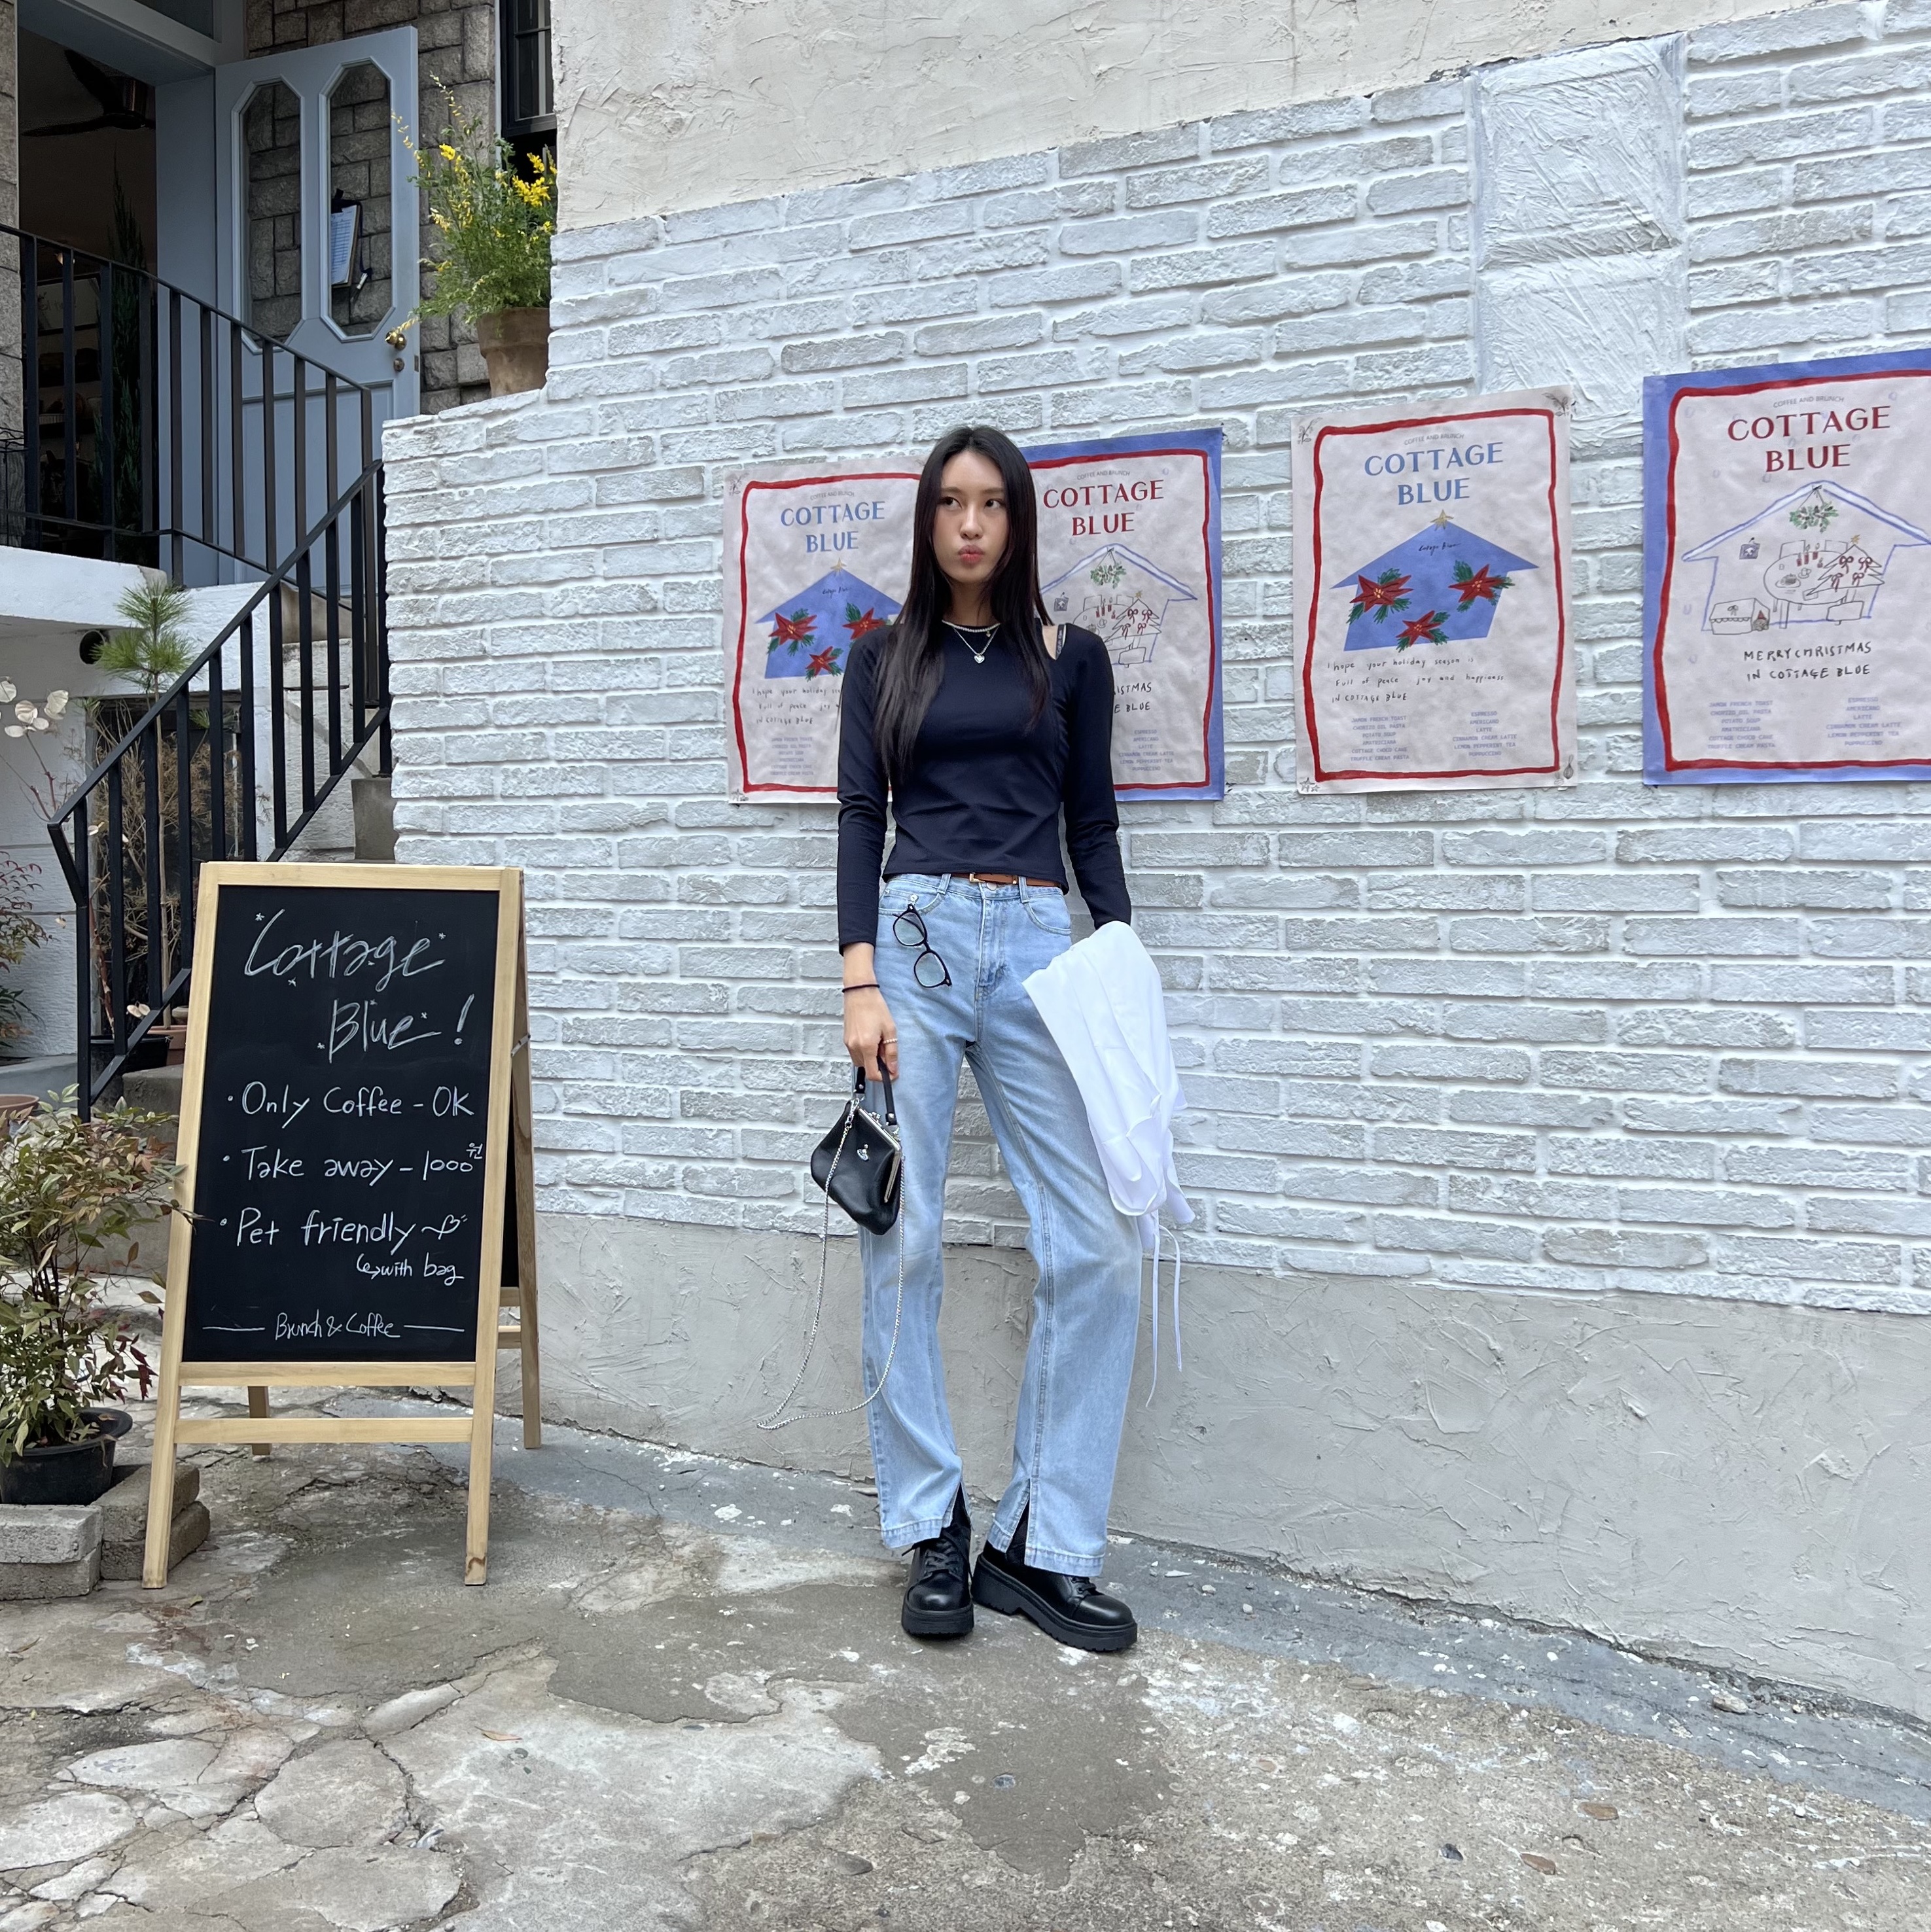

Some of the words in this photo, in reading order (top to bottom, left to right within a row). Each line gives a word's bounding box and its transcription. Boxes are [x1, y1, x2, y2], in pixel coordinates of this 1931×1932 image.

[1773, 398, 1797, 408] COFFEE
[1727, 406, 1891, 441] COTTAGE
[1404, 436, 1425, 446] COFFEE
[1364, 442, 1504, 476] COTTAGE
[1765, 444, 1851, 472] BLUE
[1077, 472, 1095, 481] COFFEE
[1043, 480, 1164, 508] COTTAGE
[1398, 478, 1470, 506] BLUE
[781, 501, 885, 526] COTTAGE
[1072, 512, 1135, 536] BLUE
[806, 531, 859, 553] BLUE
[1334, 661, 1355, 673] hope
[1367, 662, 1387, 671] your
[1393, 657, 1425, 668] holiday
[1747, 669, 1761, 682] IN
[1769, 667, 1829, 680] COTTAGE
[1837, 664, 1870, 677] BLUE
[1114, 682, 1152, 695] ISTMAS
[1377, 677, 1398, 688] peace
[1416, 676, 1431, 685] joy
[1466, 674, 1504, 683] happiness
[1126, 701, 1151, 712] BLUE
[1345, 694, 1379, 703] COTTAGE
[1386, 691, 1407, 702] BLUE
[244, 909, 446, 992] Cottage
[328, 998, 442, 1064] Blue
[242, 1081, 310, 1129] Only
[323, 1086, 402, 1117] Coffee
[432, 1086, 474, 1117] OK
[241, 1146, 305, 1180] Take
[324, 1158, 394, 1187] away
[237, 1206, 279, 1246] Pet
[300, 1209, 416, 1256] friendly
[381, 1258, 412, 1276] with
[423, 1252, 465, 1286] bag
